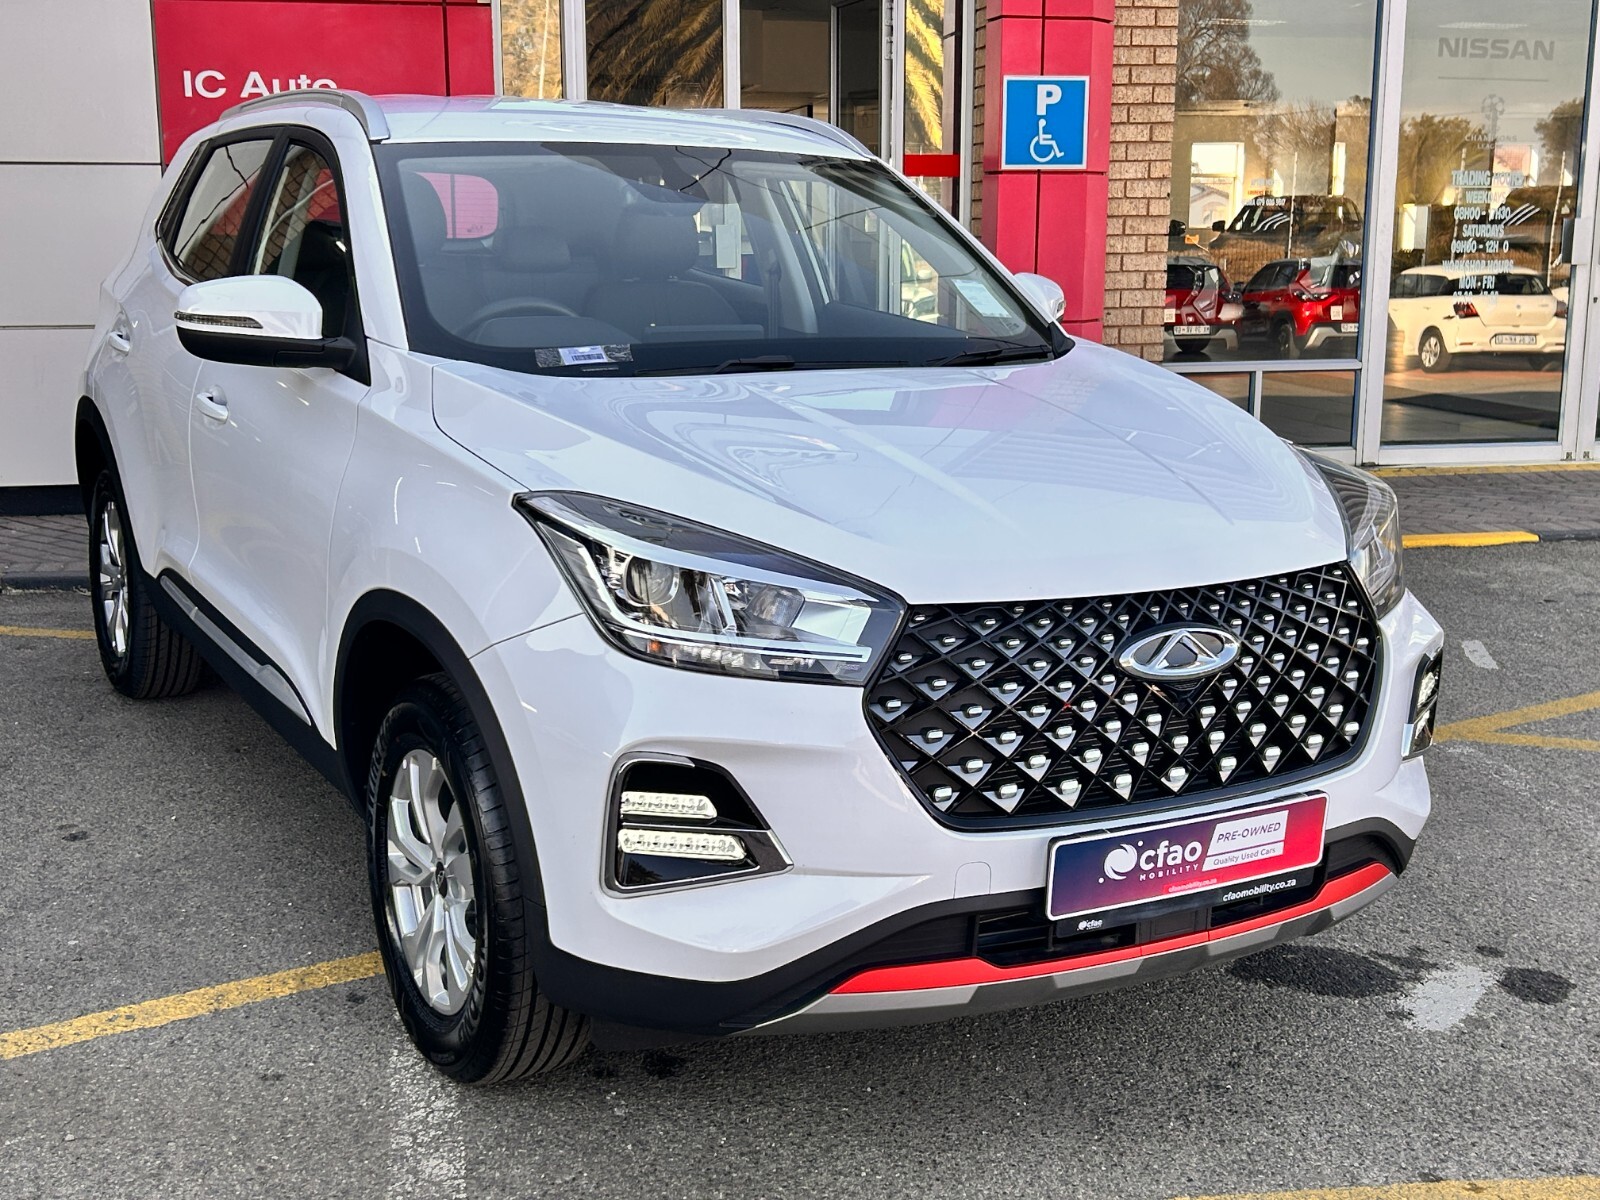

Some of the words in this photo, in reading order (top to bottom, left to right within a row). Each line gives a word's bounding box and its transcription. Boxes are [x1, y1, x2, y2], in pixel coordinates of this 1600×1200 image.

[1438, 37, 1555, 61] NISSAN
[183, 70, 226, 98] IC
[1036, 84, 1062, 115] P
[1453, 170, 1491, 186] TRADING
[1493, 171, 1525, 187] HOURS
[1465, 190, 1506, 204] WEEKDAYS
[1462, 223, 1504, 238] SATURDAYS
[1451, 240, 1477, 254] 09H00
[1485, 240, 1509, 254] 12H0
[1442, 259, 1486, 272] WORKSHOP
[1487, 260, 1514, 273] HOURS
[1458, 275, 1477, 289] MON
[1482, 275, 1495, 289] FRI
[1139, 840, 1202, 871] cfao
[1217, 822, 1281, 844] PRE-OWNED
[1213, 854, 1239, 867] Quality
[1241, 849, 1258, 861] Used
[1260, 846, 1276, 857] Cars
[1139, 863, 1199, 882] MOBILITY
[1222, 878, 1297, 902] cfaomobility.co.za
